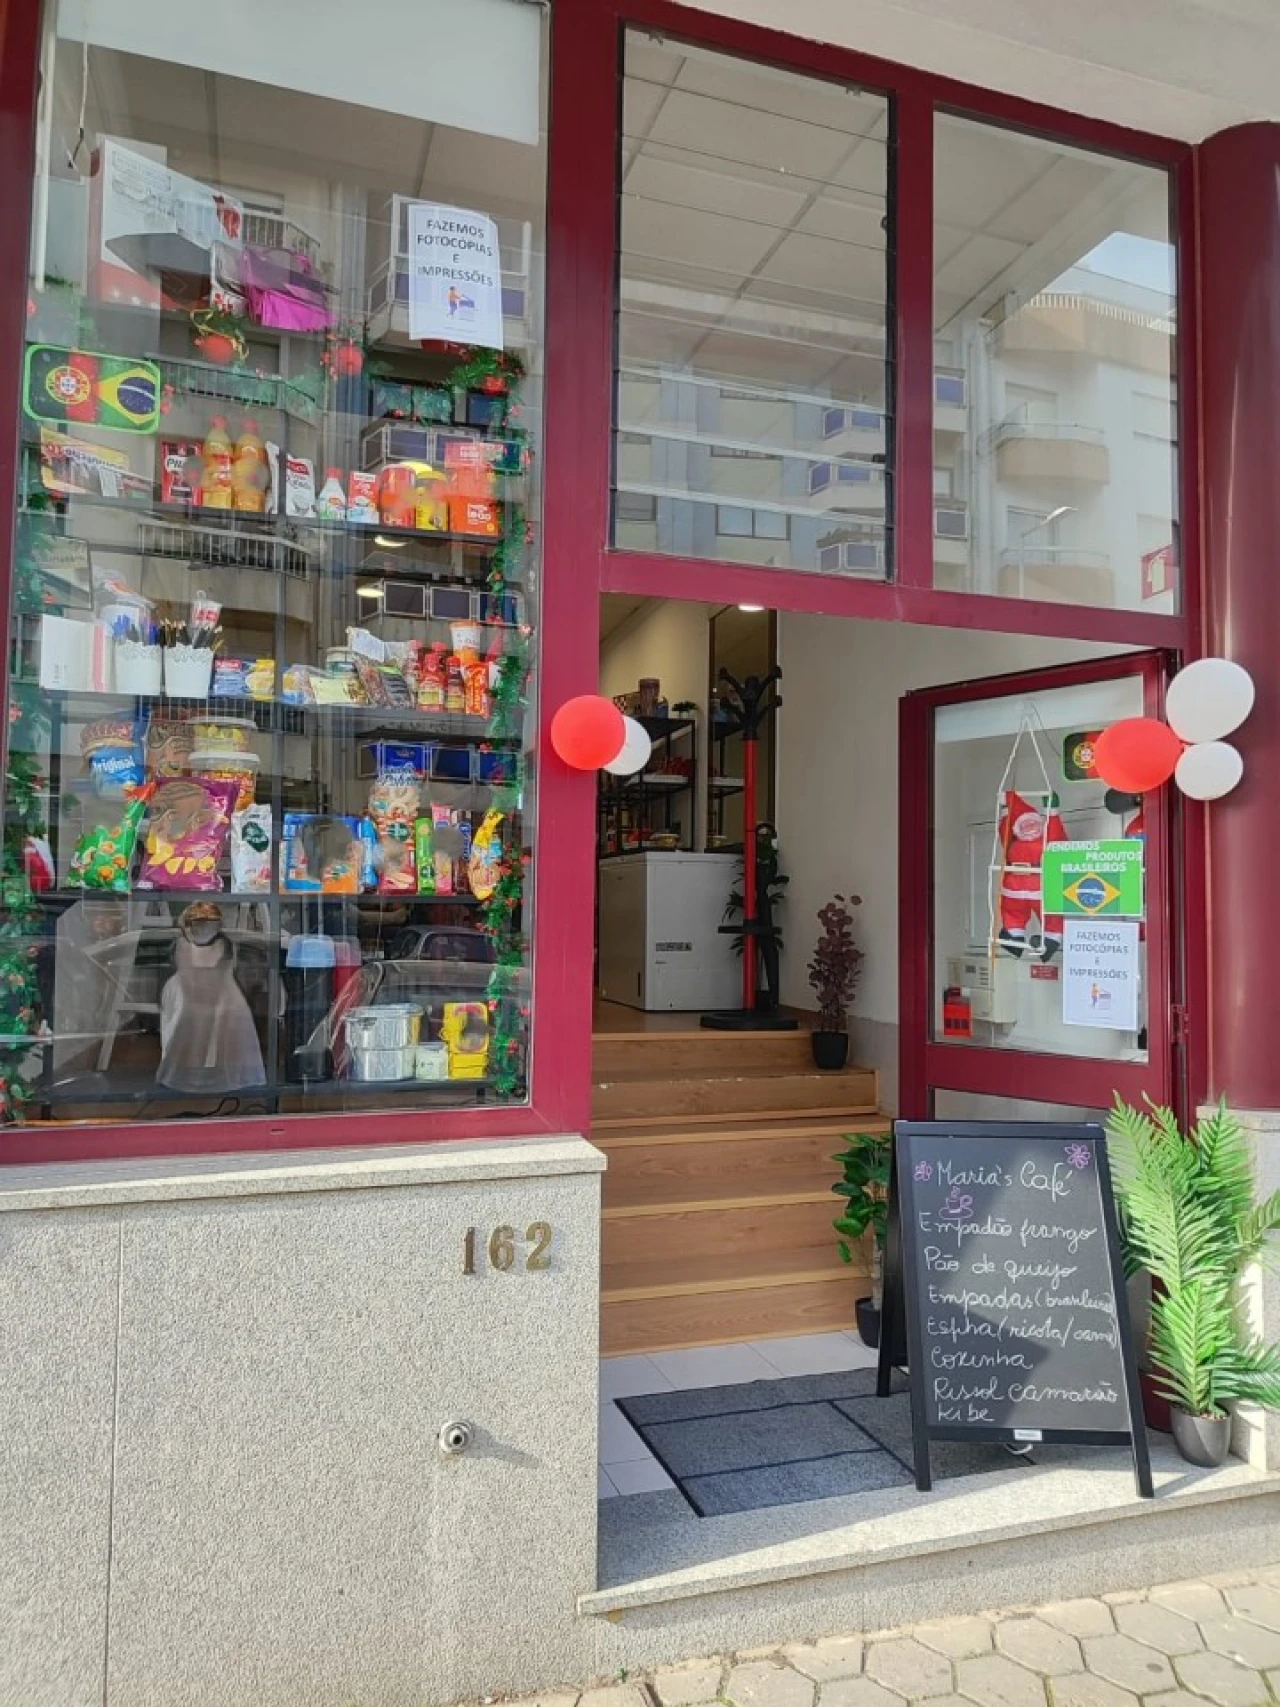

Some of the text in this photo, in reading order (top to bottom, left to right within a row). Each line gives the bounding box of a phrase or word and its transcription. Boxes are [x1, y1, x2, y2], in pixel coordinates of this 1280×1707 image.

[427, 219, 484, 239] FAZEMOS
[417, 234, 493, 257] FOTOCÓPIAS
[453, 253, 460, 264] E
[417, 266, 493, 287] IMPRESSÕES
[92, 756, 136, 774] riginal
[1061, 862, 1127, 872] BRASILEIROS
[1076, 931, 1121, 942] FAZEMOS
[1094, 956, 1100, 966] E
[1020, 1160, 1073, 1202] Café
[463, 1221, 552, 1275] 162
[972, 1253, 996, 1273] de
